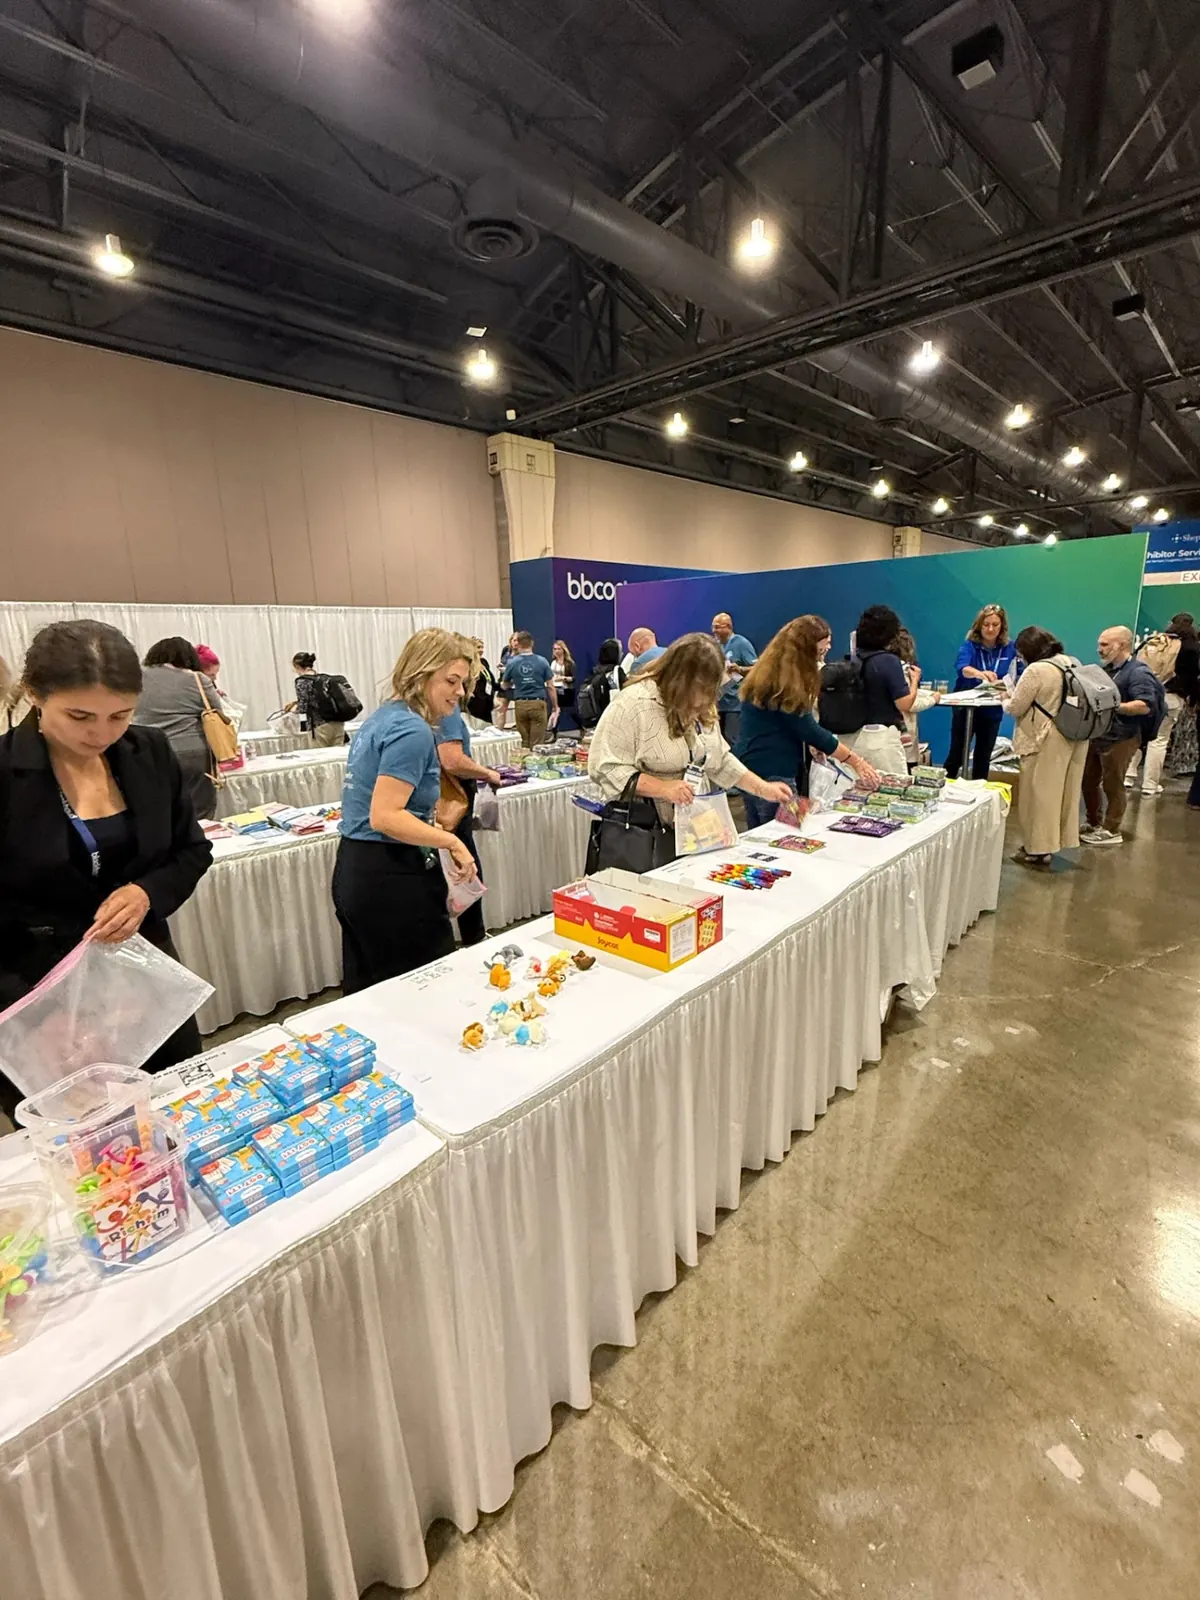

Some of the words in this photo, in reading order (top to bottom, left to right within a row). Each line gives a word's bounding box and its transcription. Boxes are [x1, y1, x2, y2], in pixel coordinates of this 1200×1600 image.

[1182, 533, 1200, 543] Shep
[1147, 550, 1176, 559] hibitor
[1178, 548, 1200, 557] Servi
[567, 571, 624, 601] bbco
[243, 1172, 264, 1187] DOT
[108, 1204, 170, 1242] Richtim
